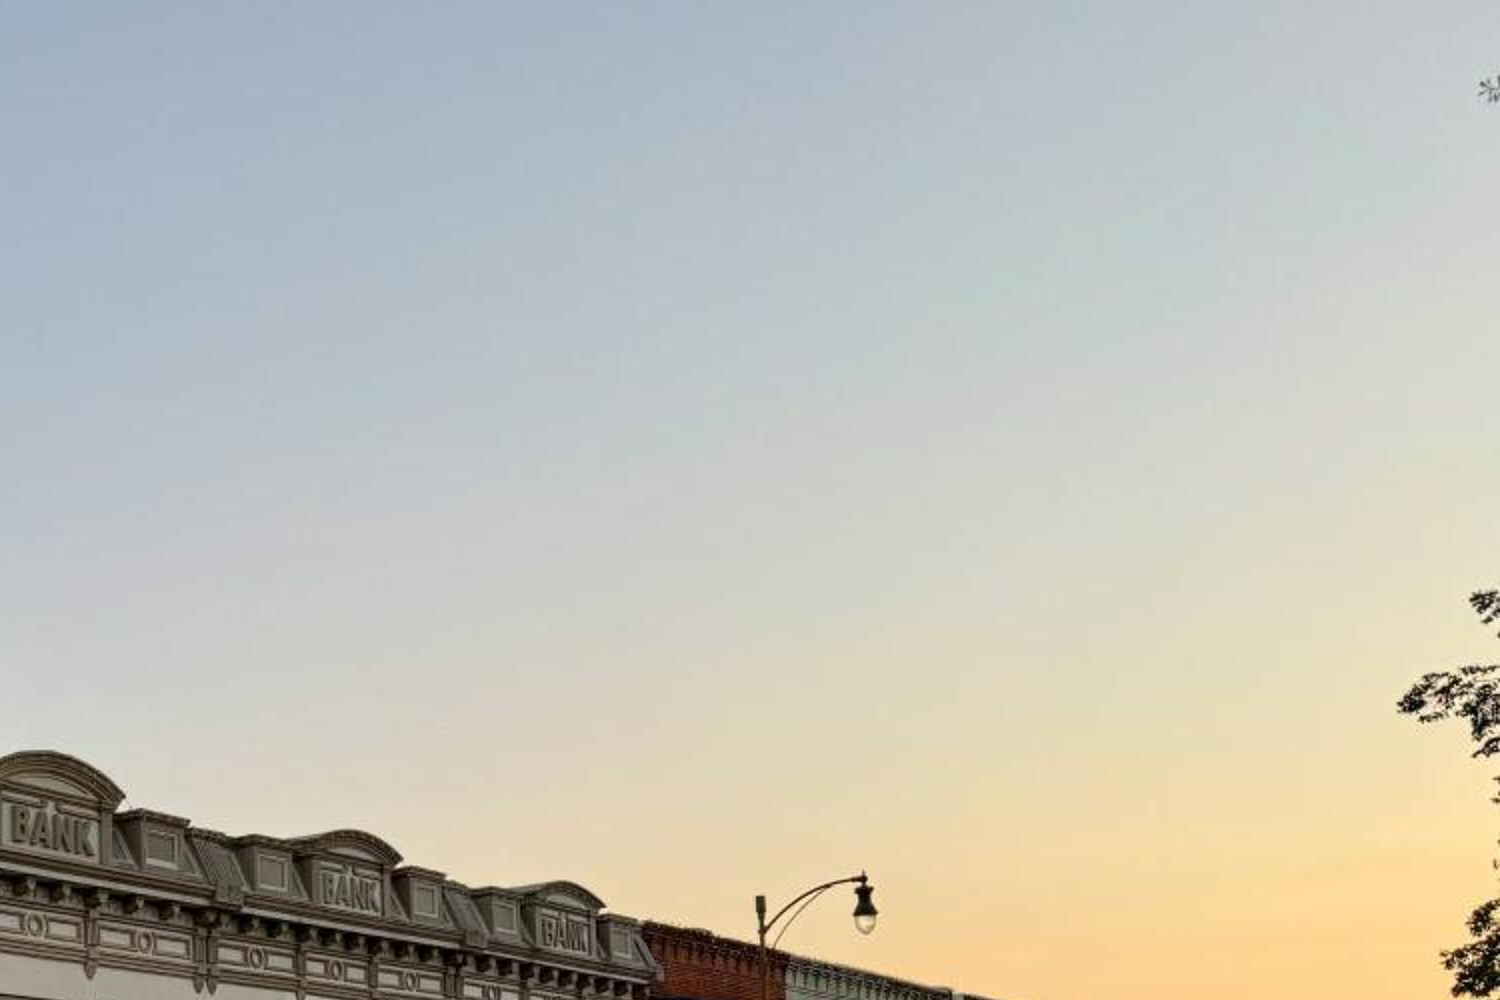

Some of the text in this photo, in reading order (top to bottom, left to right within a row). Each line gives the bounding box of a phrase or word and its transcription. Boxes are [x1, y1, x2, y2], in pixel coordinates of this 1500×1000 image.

[11, 804, 97, 857] BANK
[323, 869, 380, 912] BANK
[541, 917, 587, 952] BANK
